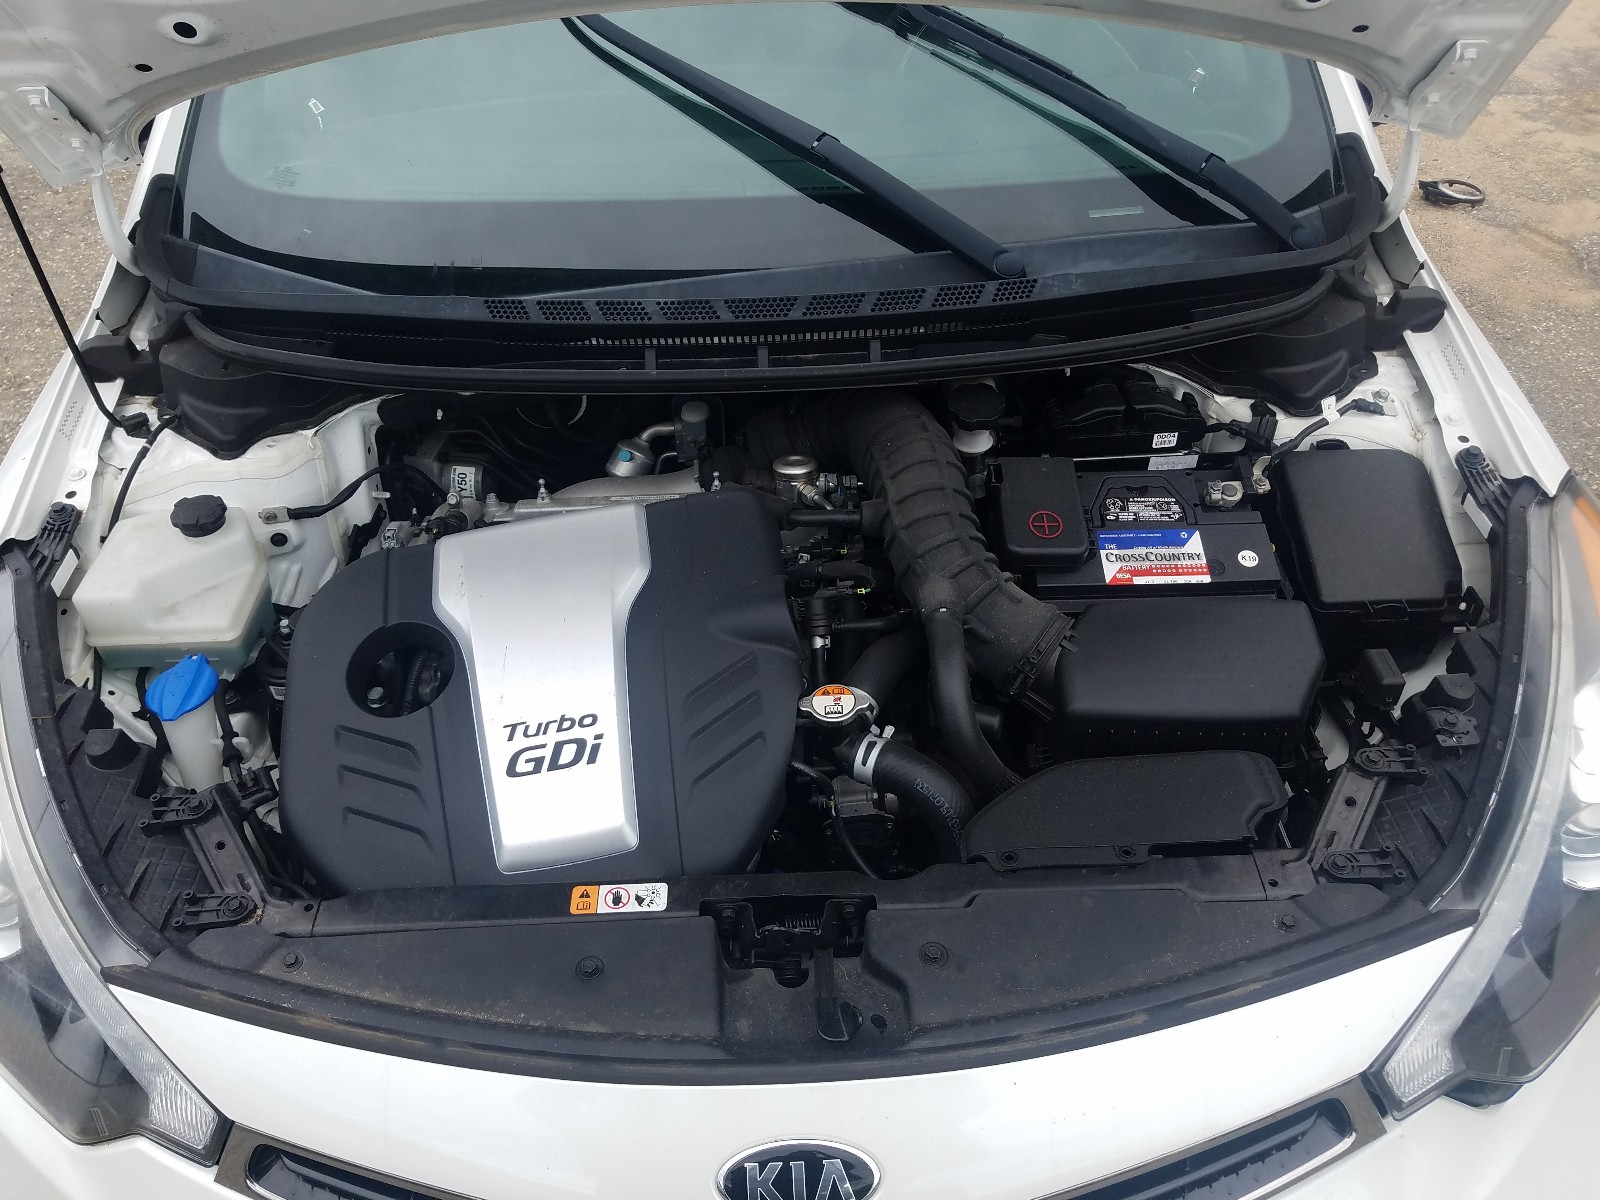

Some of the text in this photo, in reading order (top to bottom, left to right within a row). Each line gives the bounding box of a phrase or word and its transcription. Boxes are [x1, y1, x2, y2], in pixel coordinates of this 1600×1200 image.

[457, 472, 468, 493] Y50
[503, 713, 599, 742] Turbo
[505, 733, 604, 778] GDi
[744, 1159, 856, 1200] KIA
